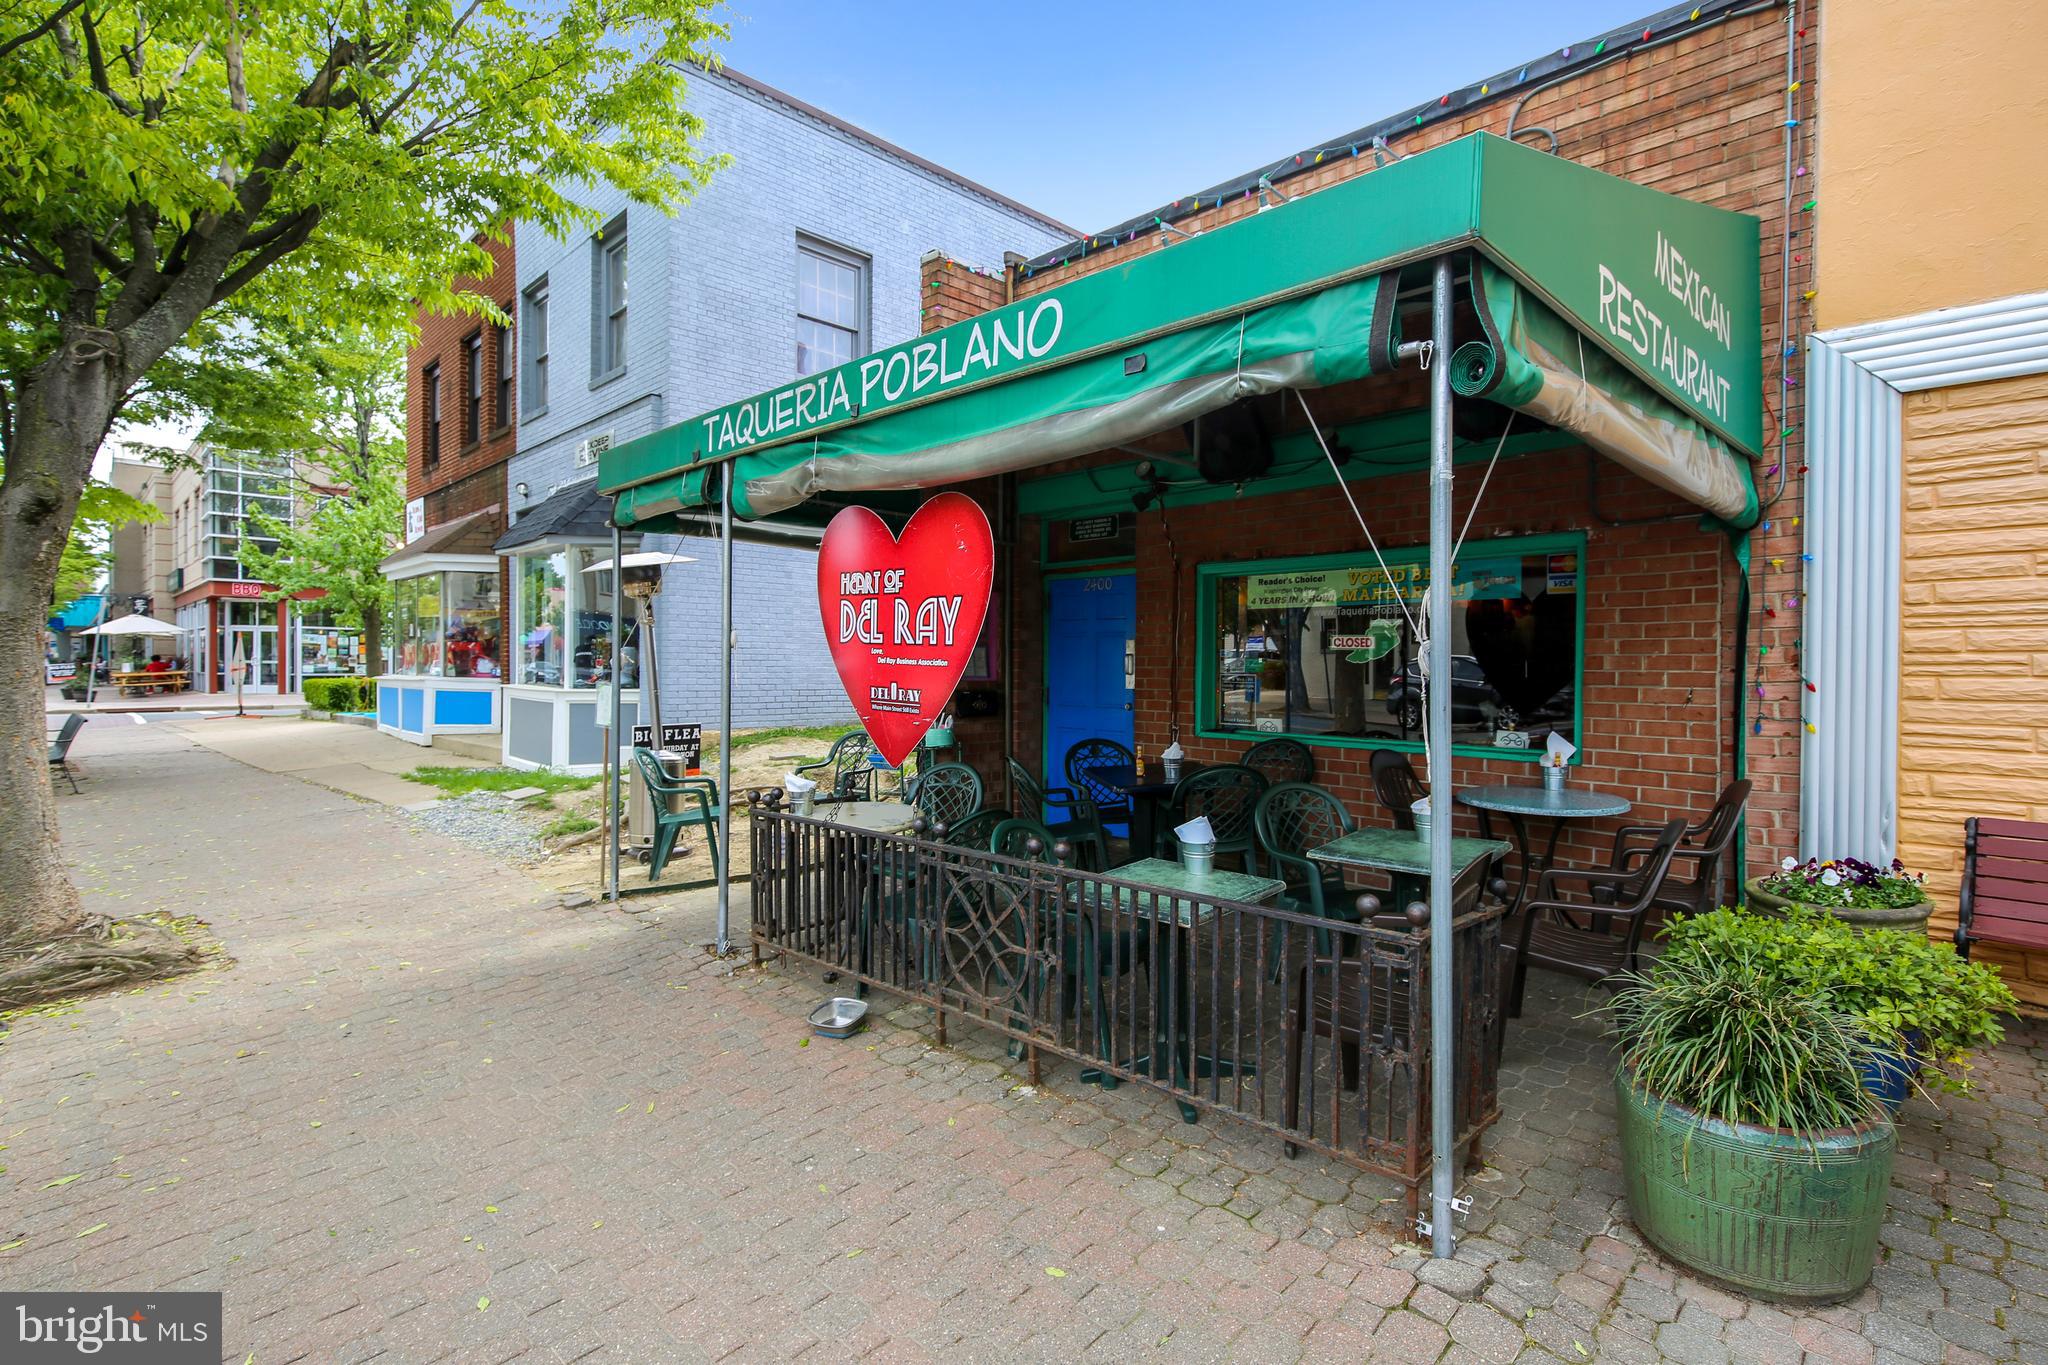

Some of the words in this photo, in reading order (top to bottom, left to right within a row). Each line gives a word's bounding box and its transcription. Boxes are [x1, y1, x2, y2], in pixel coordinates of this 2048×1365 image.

[1654, 230, 1730, 351] MEXICAN
[1598, 263, 1731, 423] RESTAURANT
[703, 368, 851, 452] TAQUERIA
[860, 298, 1064, 408] POBLANO
[840, 571, 881, 595] HEART
[883, 569, 905, 594] OF
[1258, 577, 1293, 586] Reader's
[1294, 574, 1326, 584] Choice!
[1347, 569, 1407, 586] VOTED
[1411, 565, 1459, 582] BET
[232, 583, 261, 597] BBQ
[1083, 577, 1113, 592] 2400
[1258, 596, 1288, 605] YEARS
[1289, 596, 1298, 604] IN
[840, 597, 884, 644] DEL
[893, 595, 963, 646] RAY
[1333, 637, 1372, 648] CLOSED
[871, 647, 884, 655] Love,
[877, 656, 887, 664] Del
[887, 657, 896, 665] Ray
[896, 658, 917, 666] Business
[917, 658, 948, 667] Association
[870, 686, 890, 700] DEL
[898, 688, 921, 702] RAY
[634, 731, 653, 742] BI
[664, 728, 701, 740] FLEA
